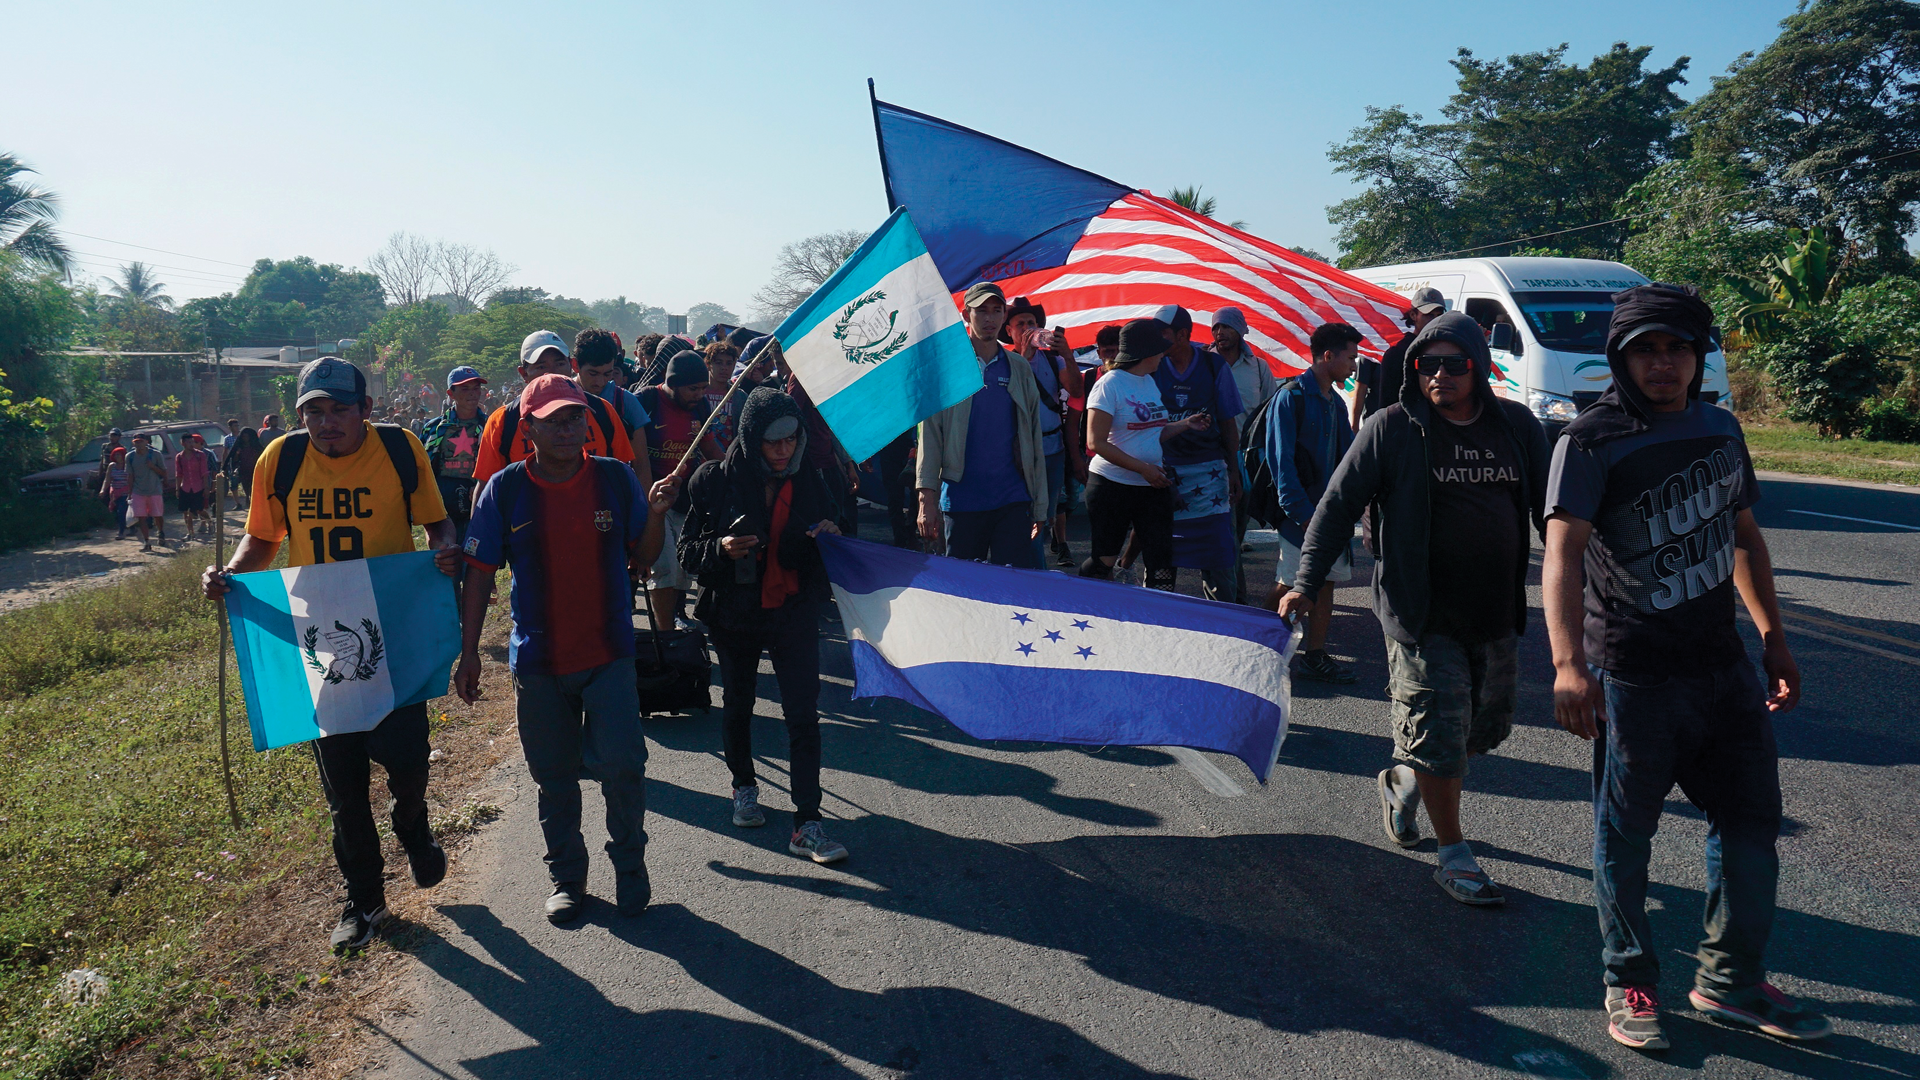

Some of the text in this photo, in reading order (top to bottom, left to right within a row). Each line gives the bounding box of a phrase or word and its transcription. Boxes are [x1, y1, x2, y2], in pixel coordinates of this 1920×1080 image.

[1521, 279, 1582, 288] TAPACHULA
[1454, 444, 1495, 460] I'm a
[298, 487, 373, 522] THE LBC
